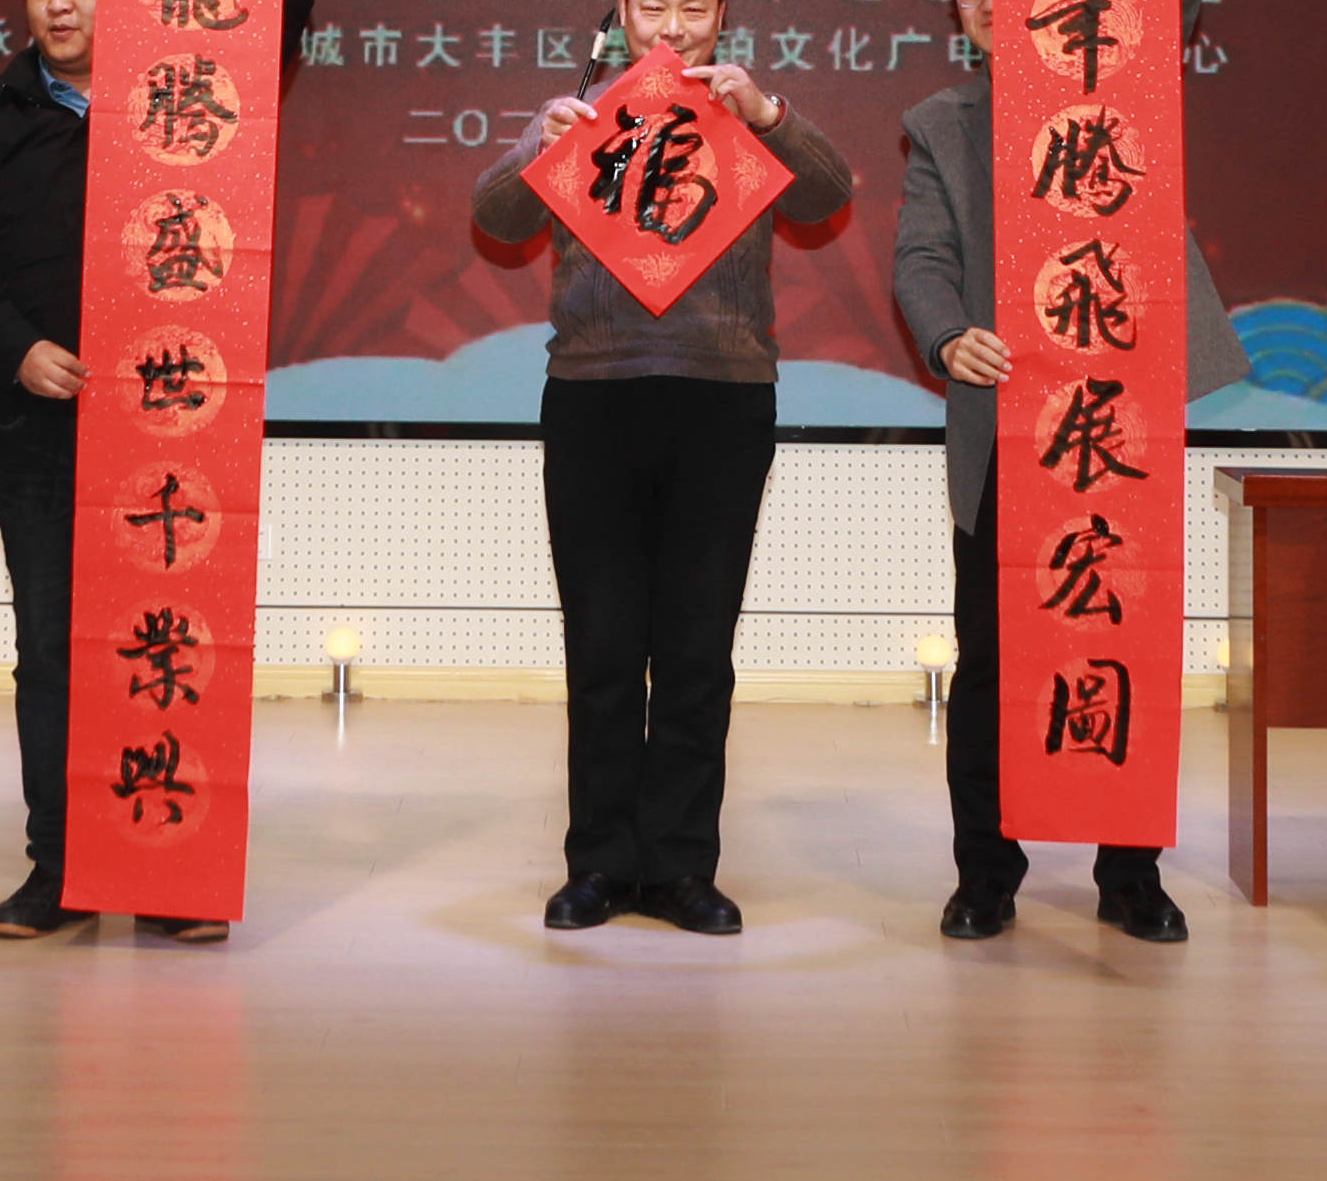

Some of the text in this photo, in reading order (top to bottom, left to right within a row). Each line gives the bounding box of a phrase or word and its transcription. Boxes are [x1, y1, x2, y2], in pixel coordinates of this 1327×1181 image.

[301, 26, 983, 72] 城市大丰区草镇文化广电
[589, 103, 718, 245] 福
